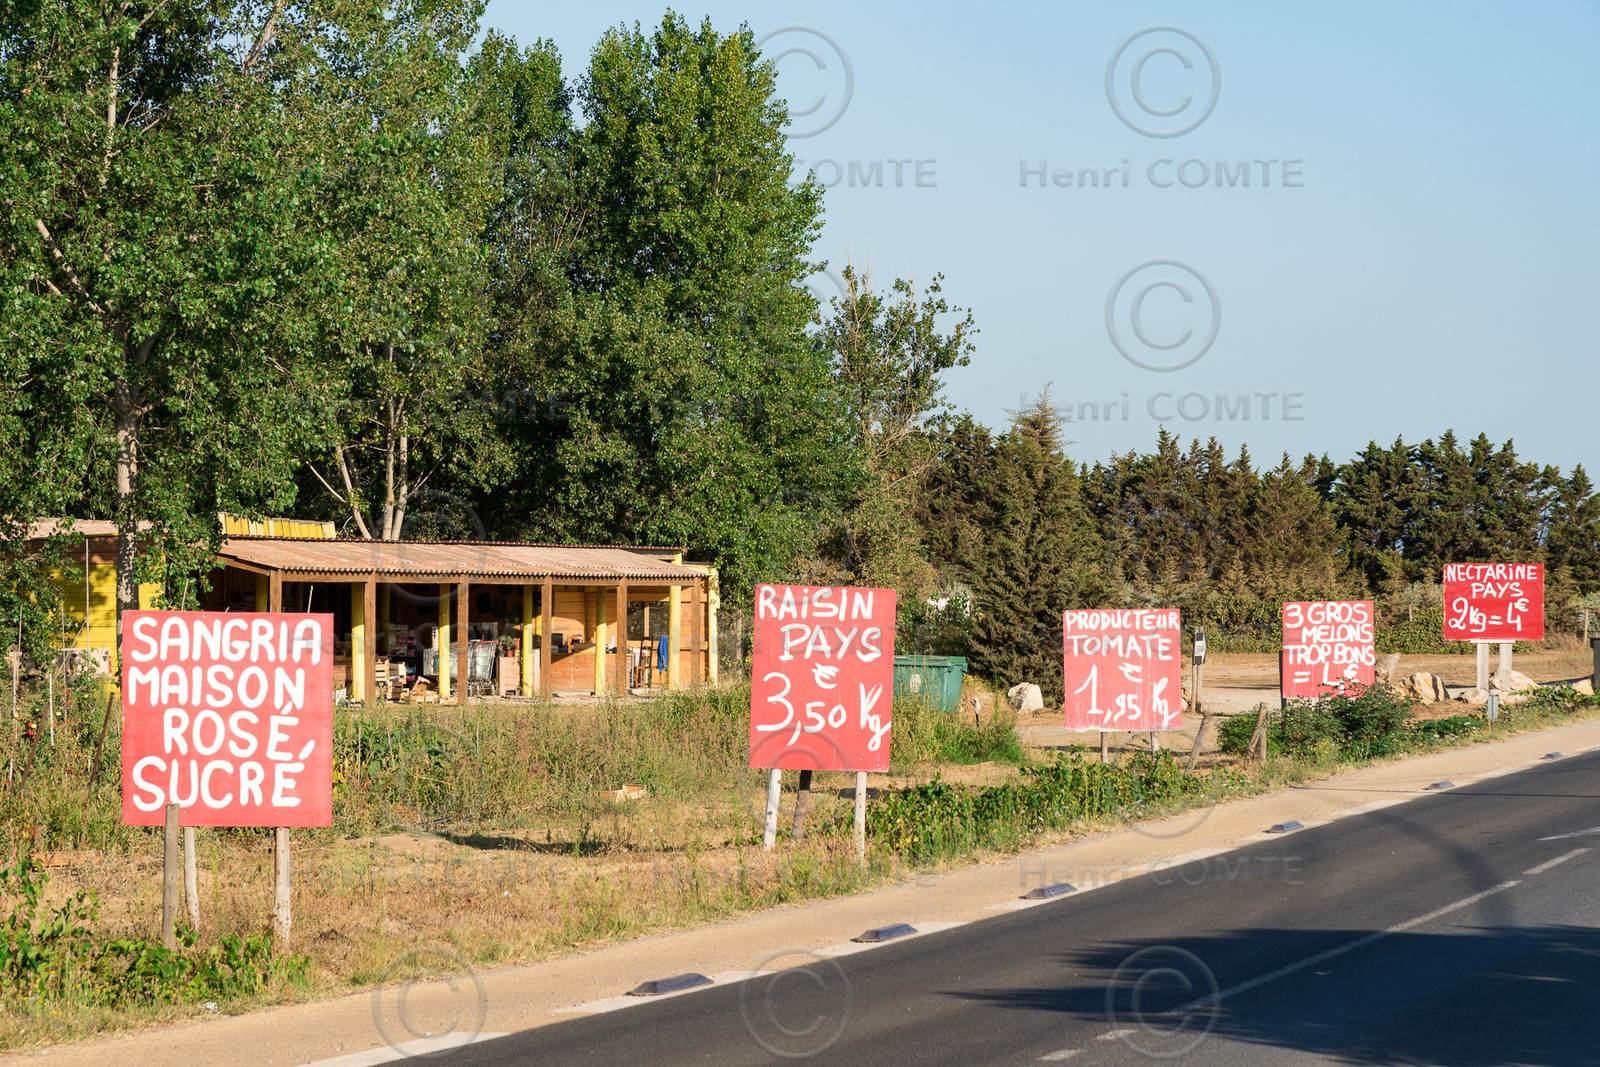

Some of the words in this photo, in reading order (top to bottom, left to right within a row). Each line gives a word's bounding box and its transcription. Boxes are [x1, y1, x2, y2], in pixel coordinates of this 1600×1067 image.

[1471, 582, 1524, 599] PAYS
[1285, 603, 1304, 628] 3
[1307, 602, 1368, 624] GROS
[1301, 623, 1373, 643] MELONS
[131, 616, 322, 666] SANGRIA
[779, 623, 882, 662] PAYS
[1066, 634, 1172, 660] TOMATE
[1282, 643, 1332, 665] TROP
[1332, 643, 1375, 666] BONS
[128, 664, 305, 710] MAISON
[1074, 664, 1141, 725] 1,95
[756, 672, 847, 746] 3,50
[163, 701, 299, 761] ROSÉ
[132, 740, 315, 811] SUCRÉ
